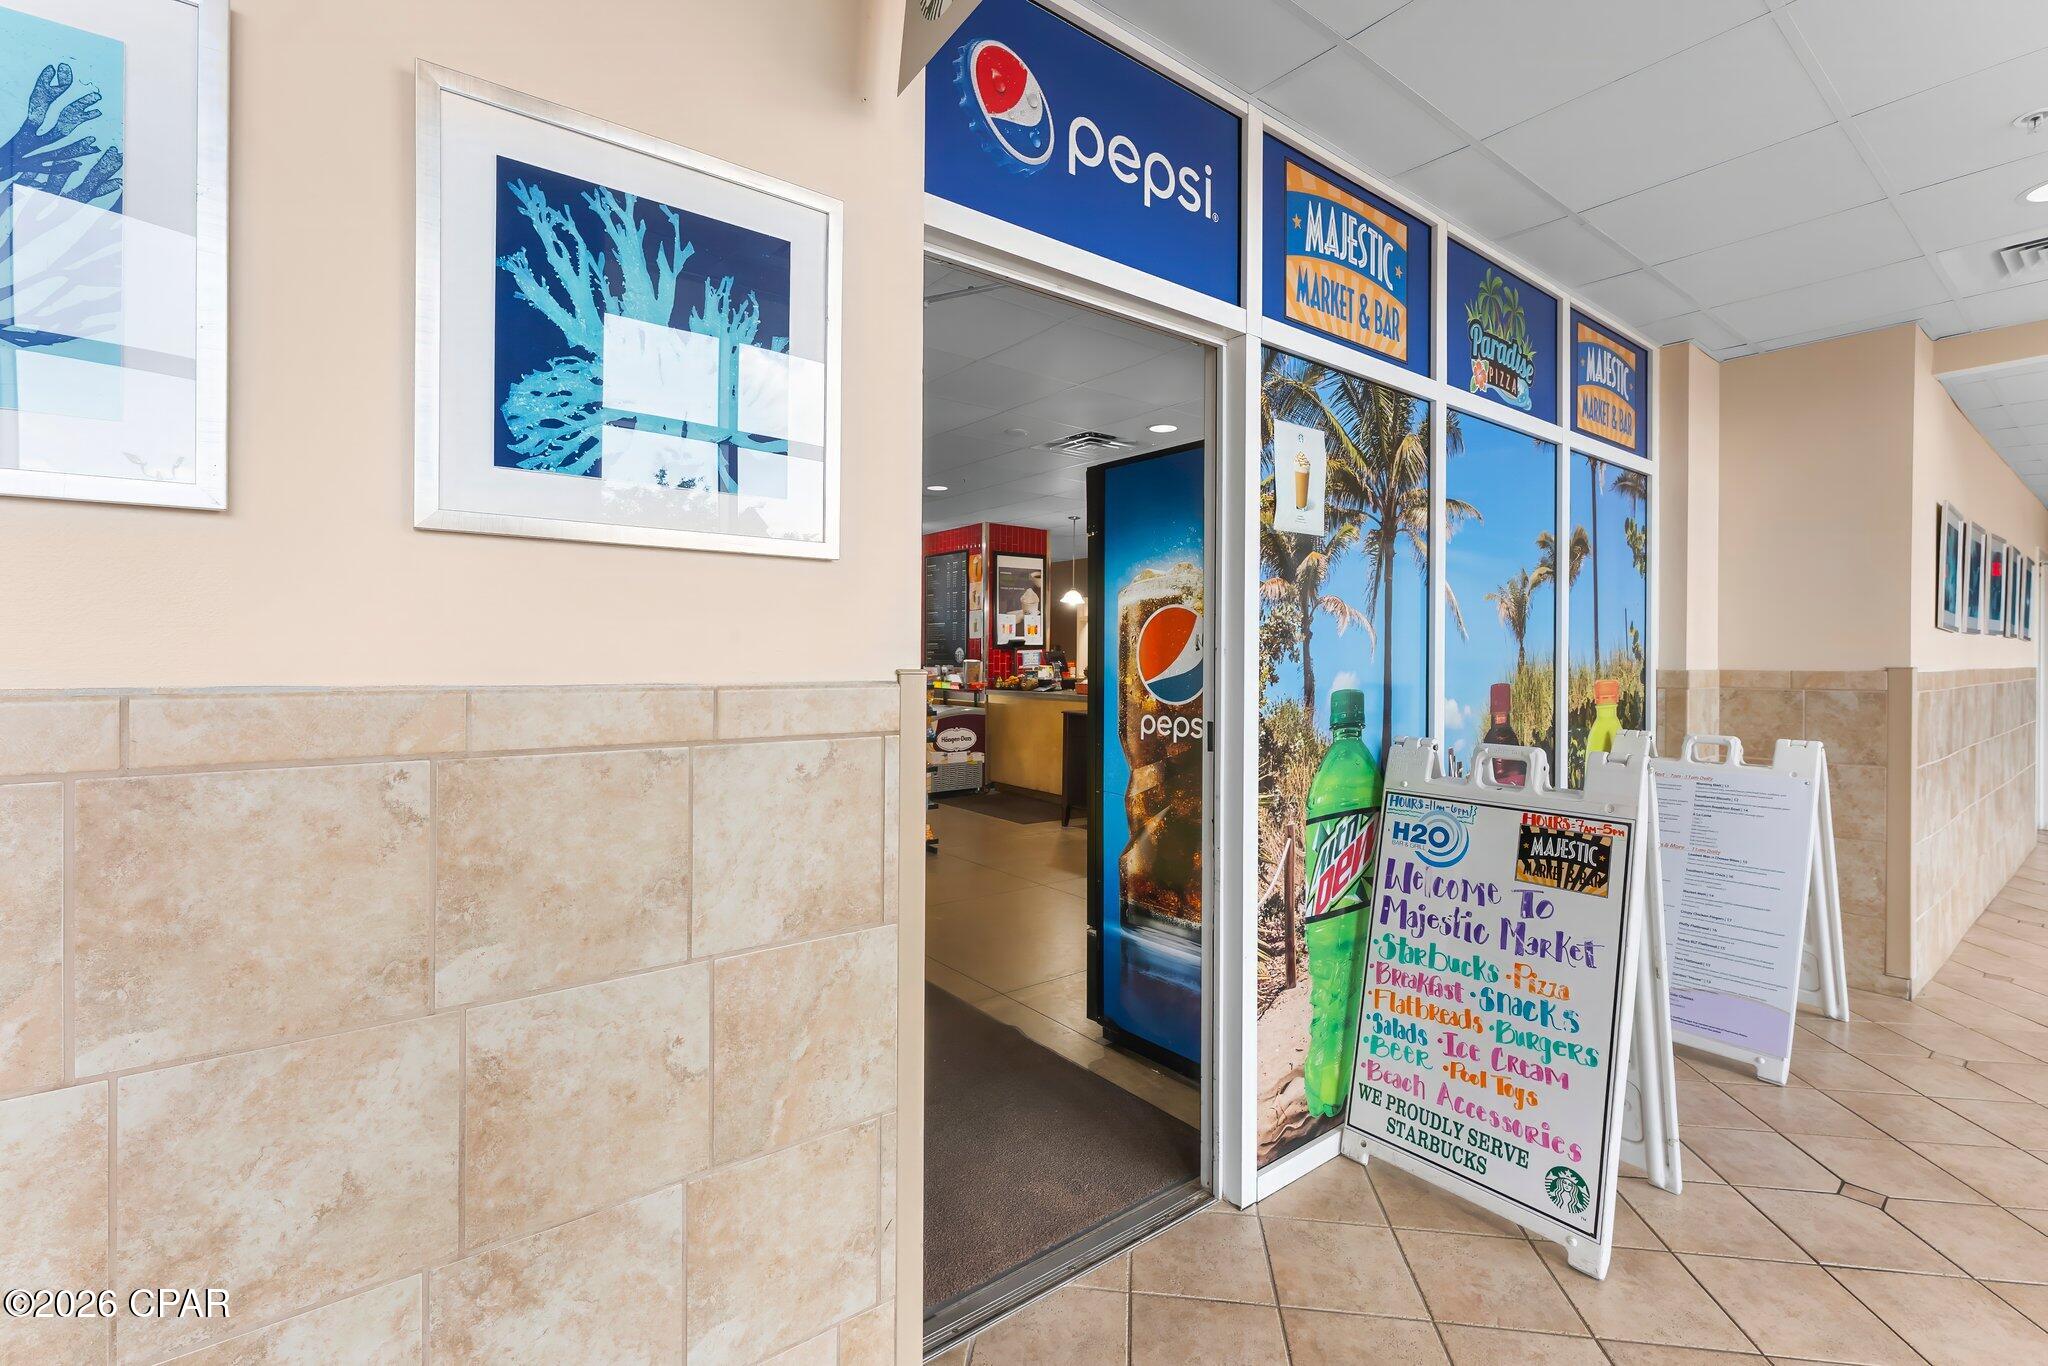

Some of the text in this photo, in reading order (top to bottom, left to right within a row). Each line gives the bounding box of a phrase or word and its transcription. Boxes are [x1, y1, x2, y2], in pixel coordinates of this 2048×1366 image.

[1068, 116, 1212, 222] pepsi
[1305, 200, 1395, 291] MAJESTIC
[1296, 269, 1401, 342] MARKET & BAR
[1470, 323, 1534, 384] Paradise
[1489, 368, 1518, 394] PIZZA
[1586, 347, 1629, 401] MAJESTIC
[1582, 397, 1632, 436] MARKET & BAR
[1141, 714, 1203, 743] peps
[1393, 821, 1449, 848] H2O
[1531, 837, 1598, 866] MAJESTIC
[1385, 858, 1555, 919] Welcome To
[1523, 860, 1565, 880] MARKET
[1580, 871, 1603, 888] BAR
[1380, 895, 1605, 968] Majestic Market
[1376, 961, 1581, 1033] Breakfast Snacks
[1379, 933, 1571, 1000] Starbucks Pizza
[1372, 1013, 1569, 1090] Salads Ice Cream
[1374, 989, 1599, 1067] Flatbreads Burgers
[1370, 1035, 1539, 1110] Beer Pool Toys
[1359, 1083, 1529, 1169] WE PROUDLY SERVE
[1366, 1059, 1583, 1162] Beach Accessories
[1387, 1118, 1487, 1175] STARBUCKS
